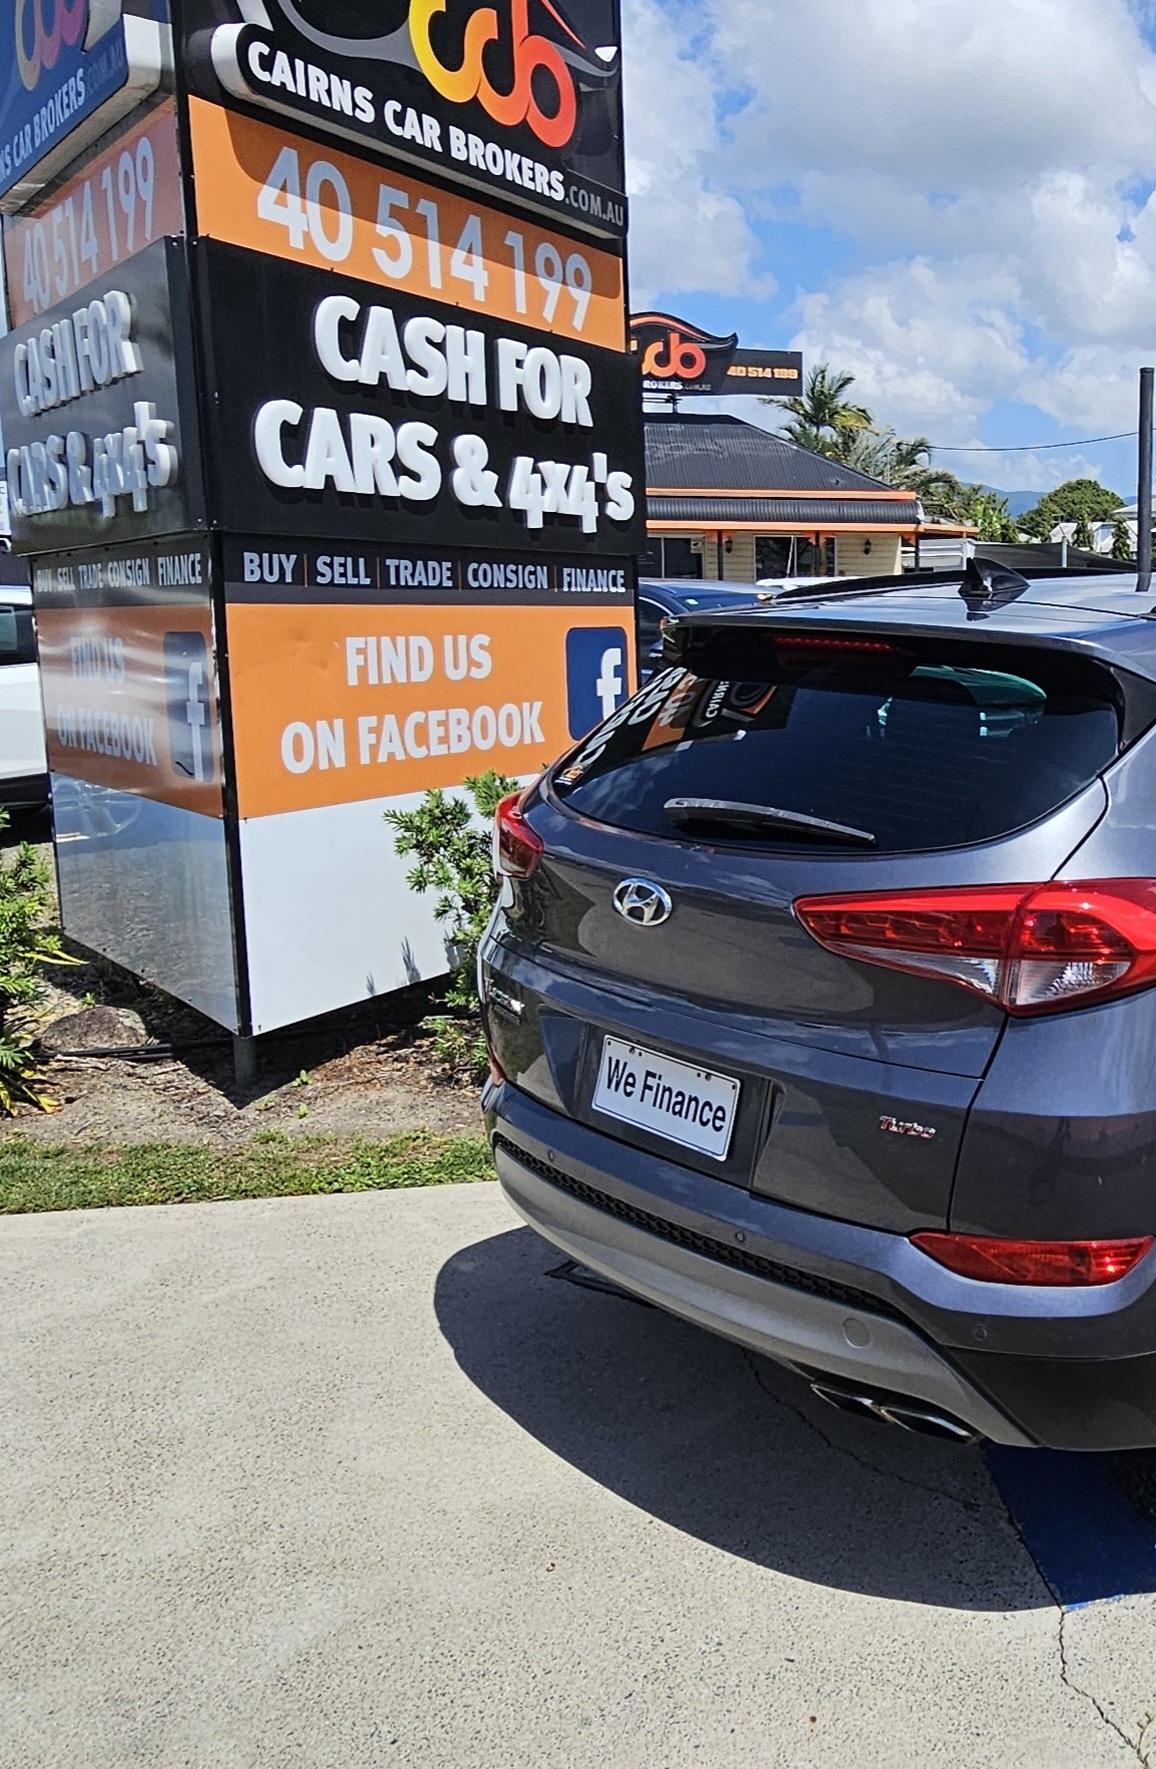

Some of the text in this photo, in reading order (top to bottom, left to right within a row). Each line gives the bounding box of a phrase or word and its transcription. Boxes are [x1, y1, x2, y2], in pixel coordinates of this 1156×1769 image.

[248, 41, 376, 124] CAIRNS
[384, 100, 443, 152] CAR
[12, 123, 33, 167] CAR
[23, 137, 154, 313] 40 514 199
[257, 146, 593, 332] 40 514 199
[14, 290, 139, 417] CASH FOR
[314, 294, 594, 428] CASH FOR
[7, 435, 68, 517] CARS
[66, 431, 95, 505] &
[254, 399, 442, 501] CARS
[453, 434, 503, 508] &
[57, 566, 75, 591] SELL
[78, 563, 103, 590] TRADE
[107, 558, 149, 588] CONSIGN
[158, 552, 203, 586] FINANCE
[243, 552, 627, 593] BUY SELL TRADE CONSIGN FINANCE
[69, 636, 125, 685] FIND US
[345, 633, 494, 687] FIND US
[57, 703, 158, 767] ON FACEBOOK
[280, 716, 347, 775] ON
[358, 701, 546, 766] FACEBOOK
[606, 1056, 727, 1133] We Finance
[879, 1115, 936, 1139] Turbo
